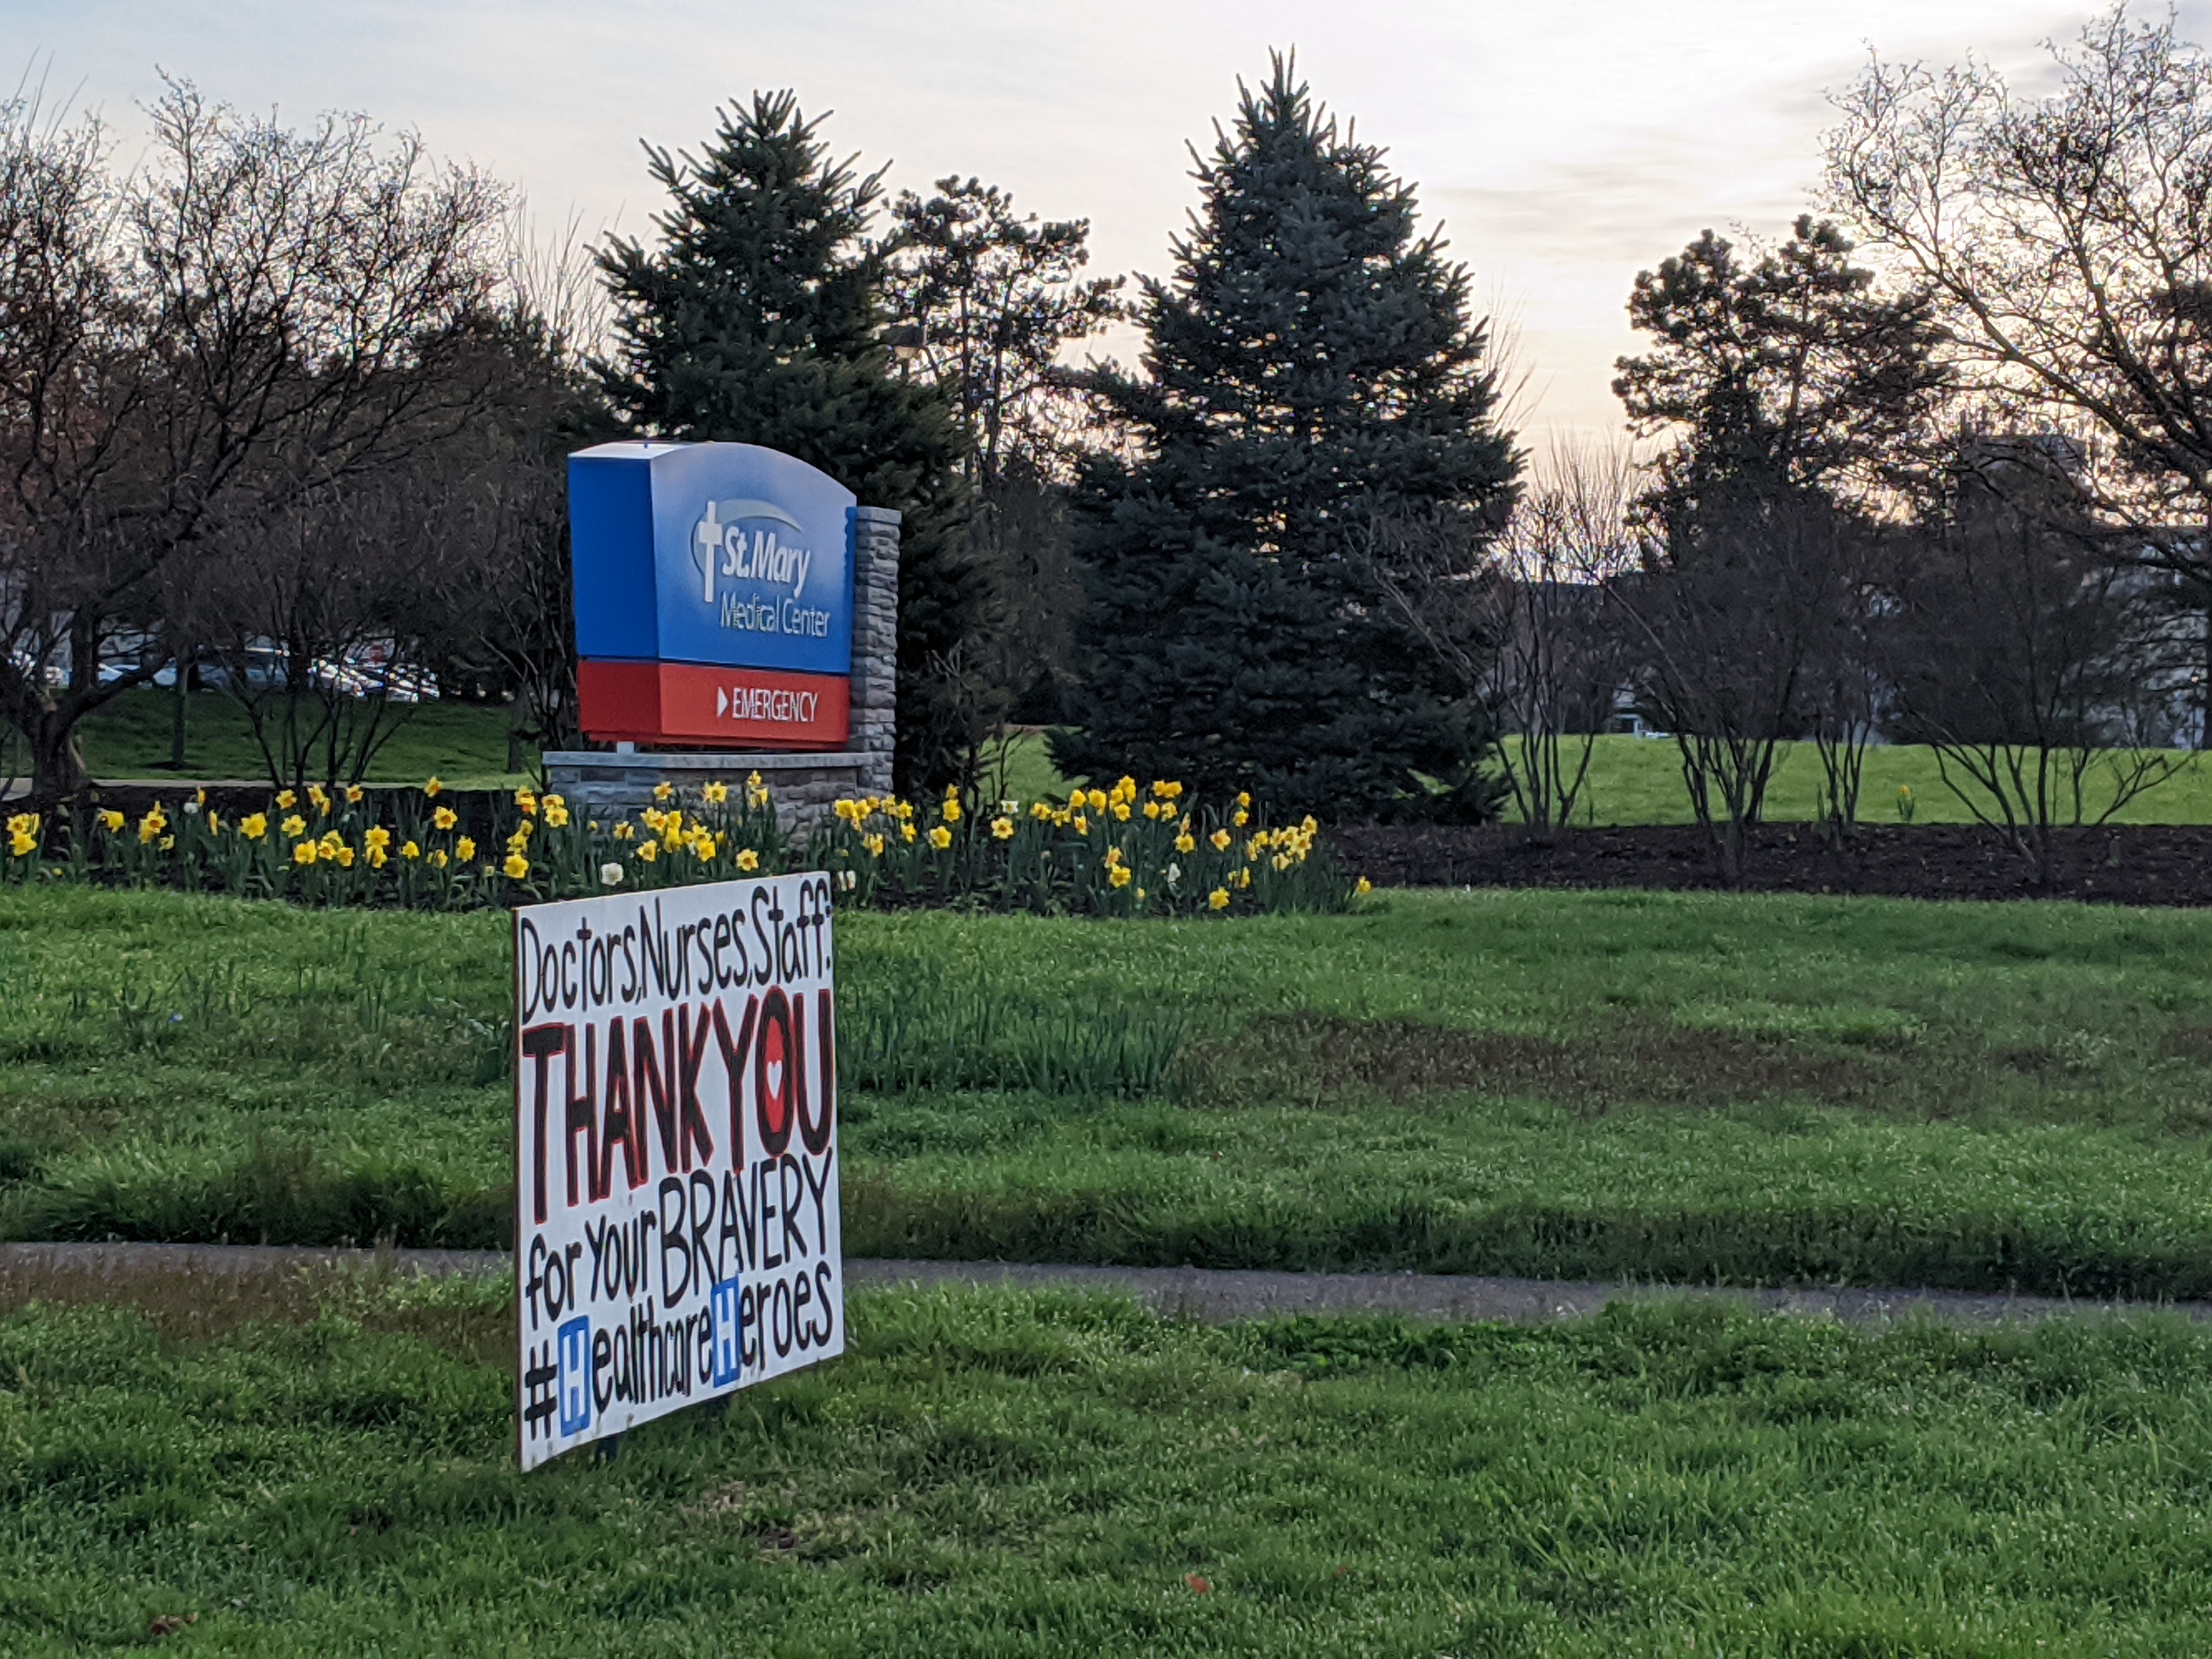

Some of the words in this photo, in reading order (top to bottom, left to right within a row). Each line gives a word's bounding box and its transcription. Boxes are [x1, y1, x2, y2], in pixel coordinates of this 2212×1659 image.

[750, 529, 810, 598] Mary
[721, 591, 780, 633] Medical
[782, 598, 830, 637] Center
[732, 687, 819, 722] EMERGENCY
[522, 1001, 714, 1225] THANK
[713, 985, 833, 1173] YOU
[525, 1233, 583, 1331] for
[584, 1209, 657, 1302] Your
[658, 1147, 833, 1309] BRAVERY
